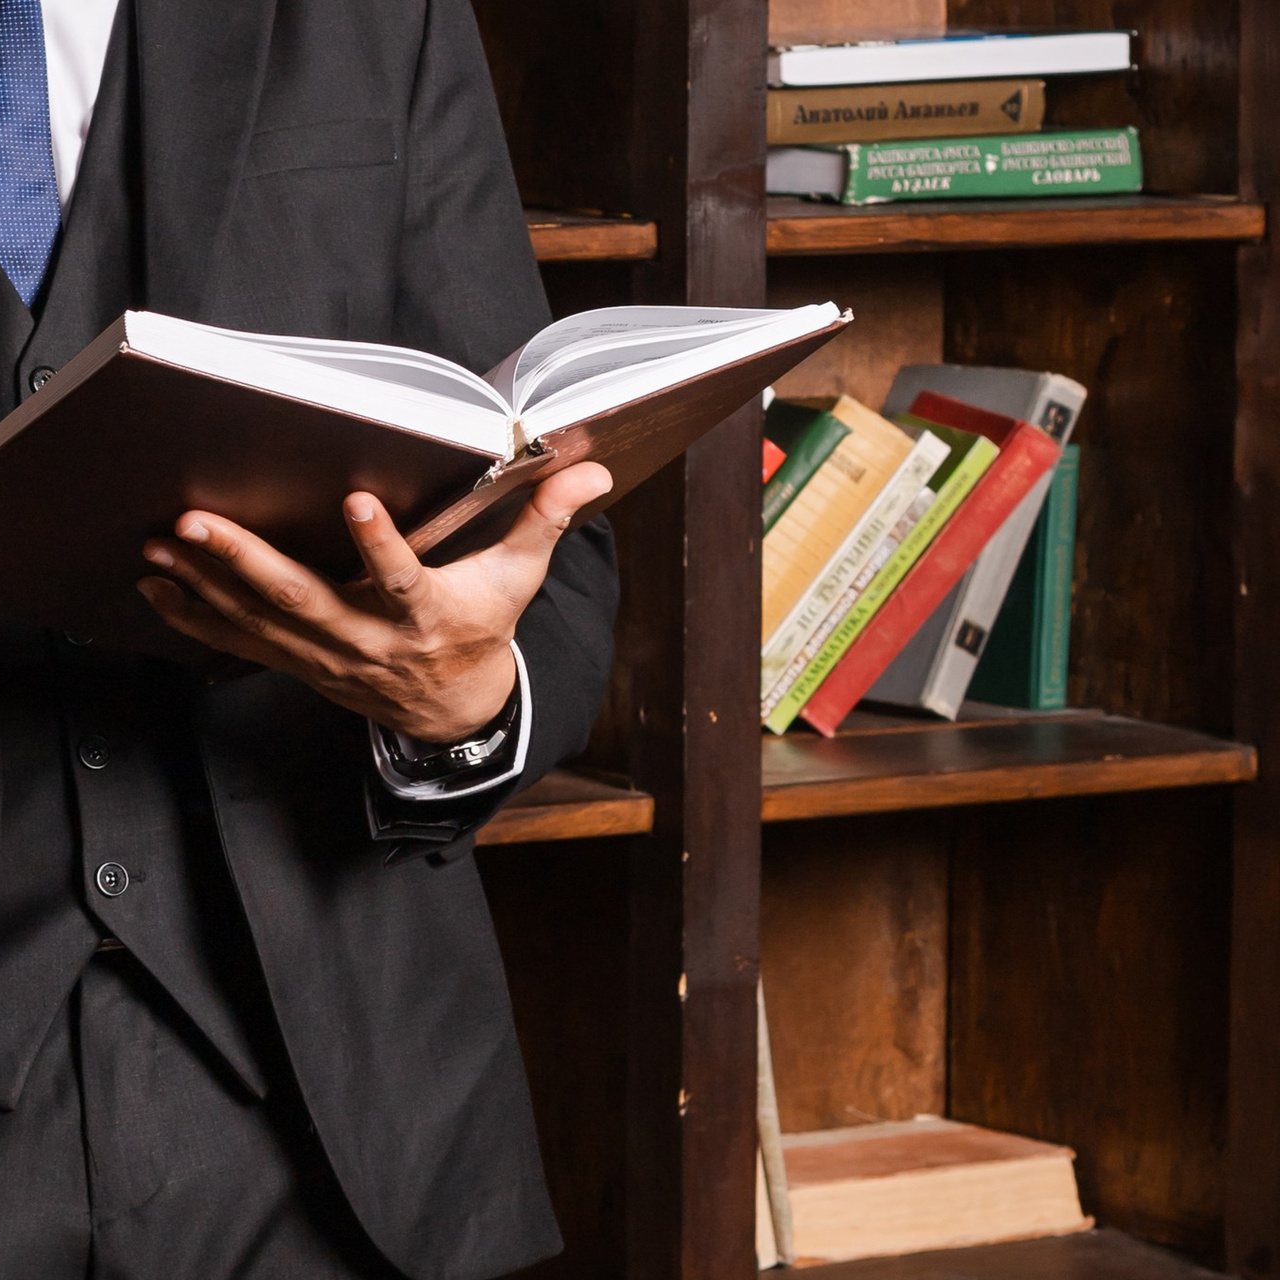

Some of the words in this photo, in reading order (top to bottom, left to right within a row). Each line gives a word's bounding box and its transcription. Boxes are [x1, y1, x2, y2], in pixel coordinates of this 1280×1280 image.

[793, 101, 889, 125] Анатолий
[893, 101, 979, 121] Ананьев
[1031, 168, 1101, 186] СЛОВАРЬ
[790, 608, 867, 702] ГРАММАТИКА
